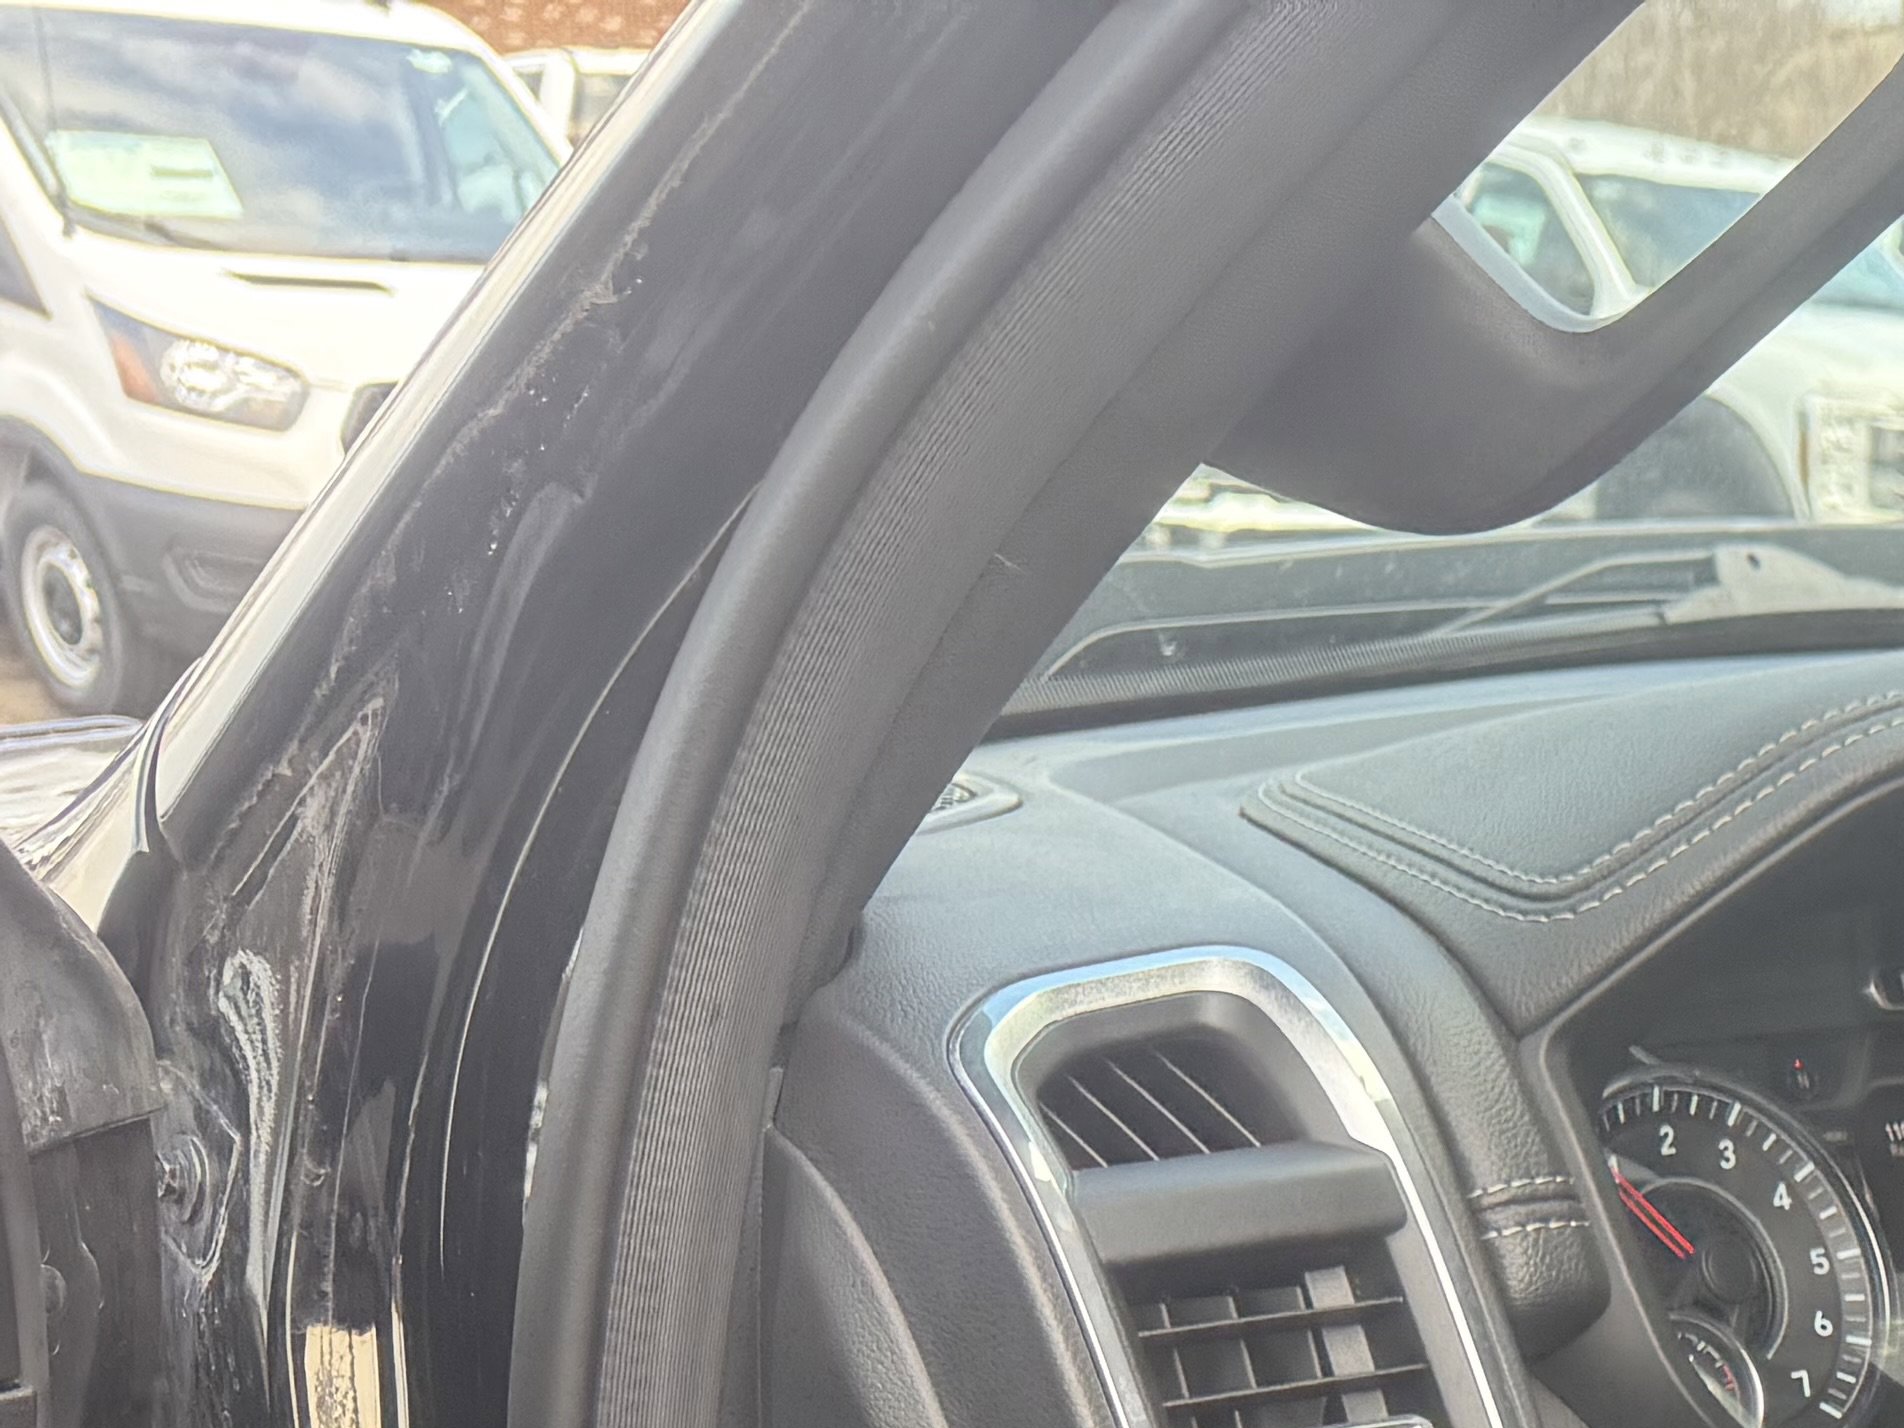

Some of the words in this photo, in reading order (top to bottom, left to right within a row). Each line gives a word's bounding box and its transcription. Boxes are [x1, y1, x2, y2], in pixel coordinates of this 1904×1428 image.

[1658, 1124, 1677, 1156] 2
[1718, 1138, 1736, 1170] 3
[1772, 1181, 1792, 1211] 4
[1809, 1247, 1830, 1275] 5
[1813, 1310, 1834, 1337] 6
[1790, 1368, 1811, 1398] 7
